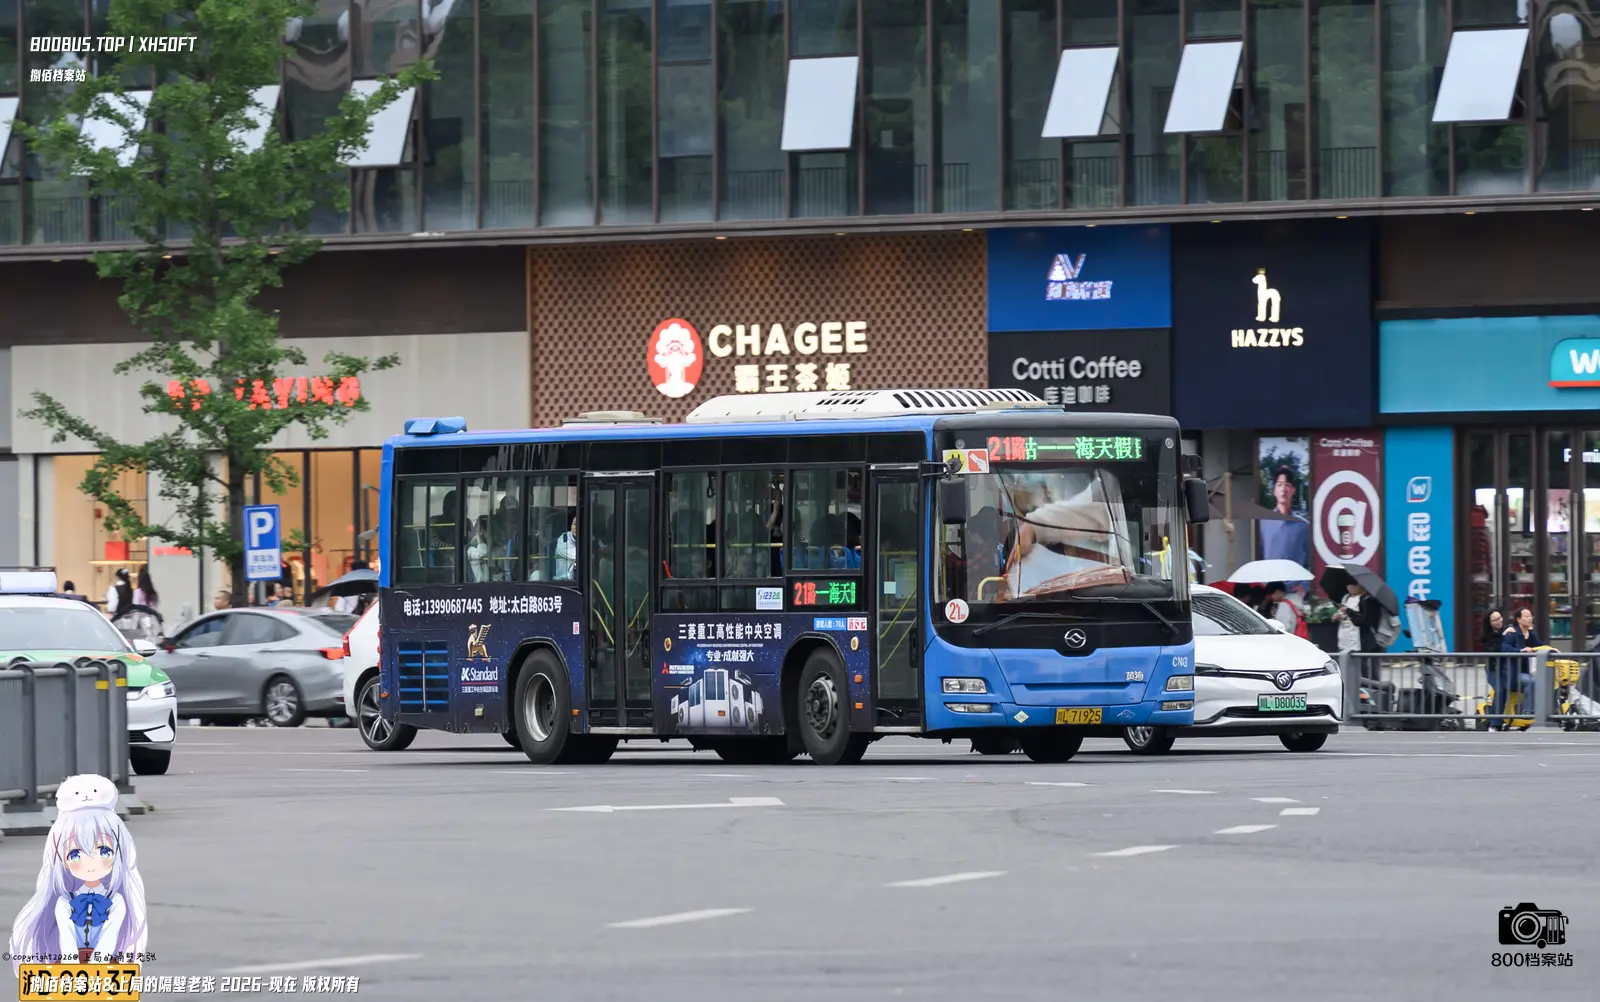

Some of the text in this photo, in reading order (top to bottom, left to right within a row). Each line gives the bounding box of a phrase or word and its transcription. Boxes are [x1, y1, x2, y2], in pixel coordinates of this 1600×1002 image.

[708, 321, 868, 358] CHAGEE
[1231, 327, 1304, 348] HAZZYS
[734, 362, 851, 393] 霸王茶姬
[1012, 355, 1142, 381] Cotti Coffee
[250, 511, 274, 548] P
[678, 623, 782, 640] 三菱重工高性能中央空调
[1172, 656, 1189, 669] CNG
